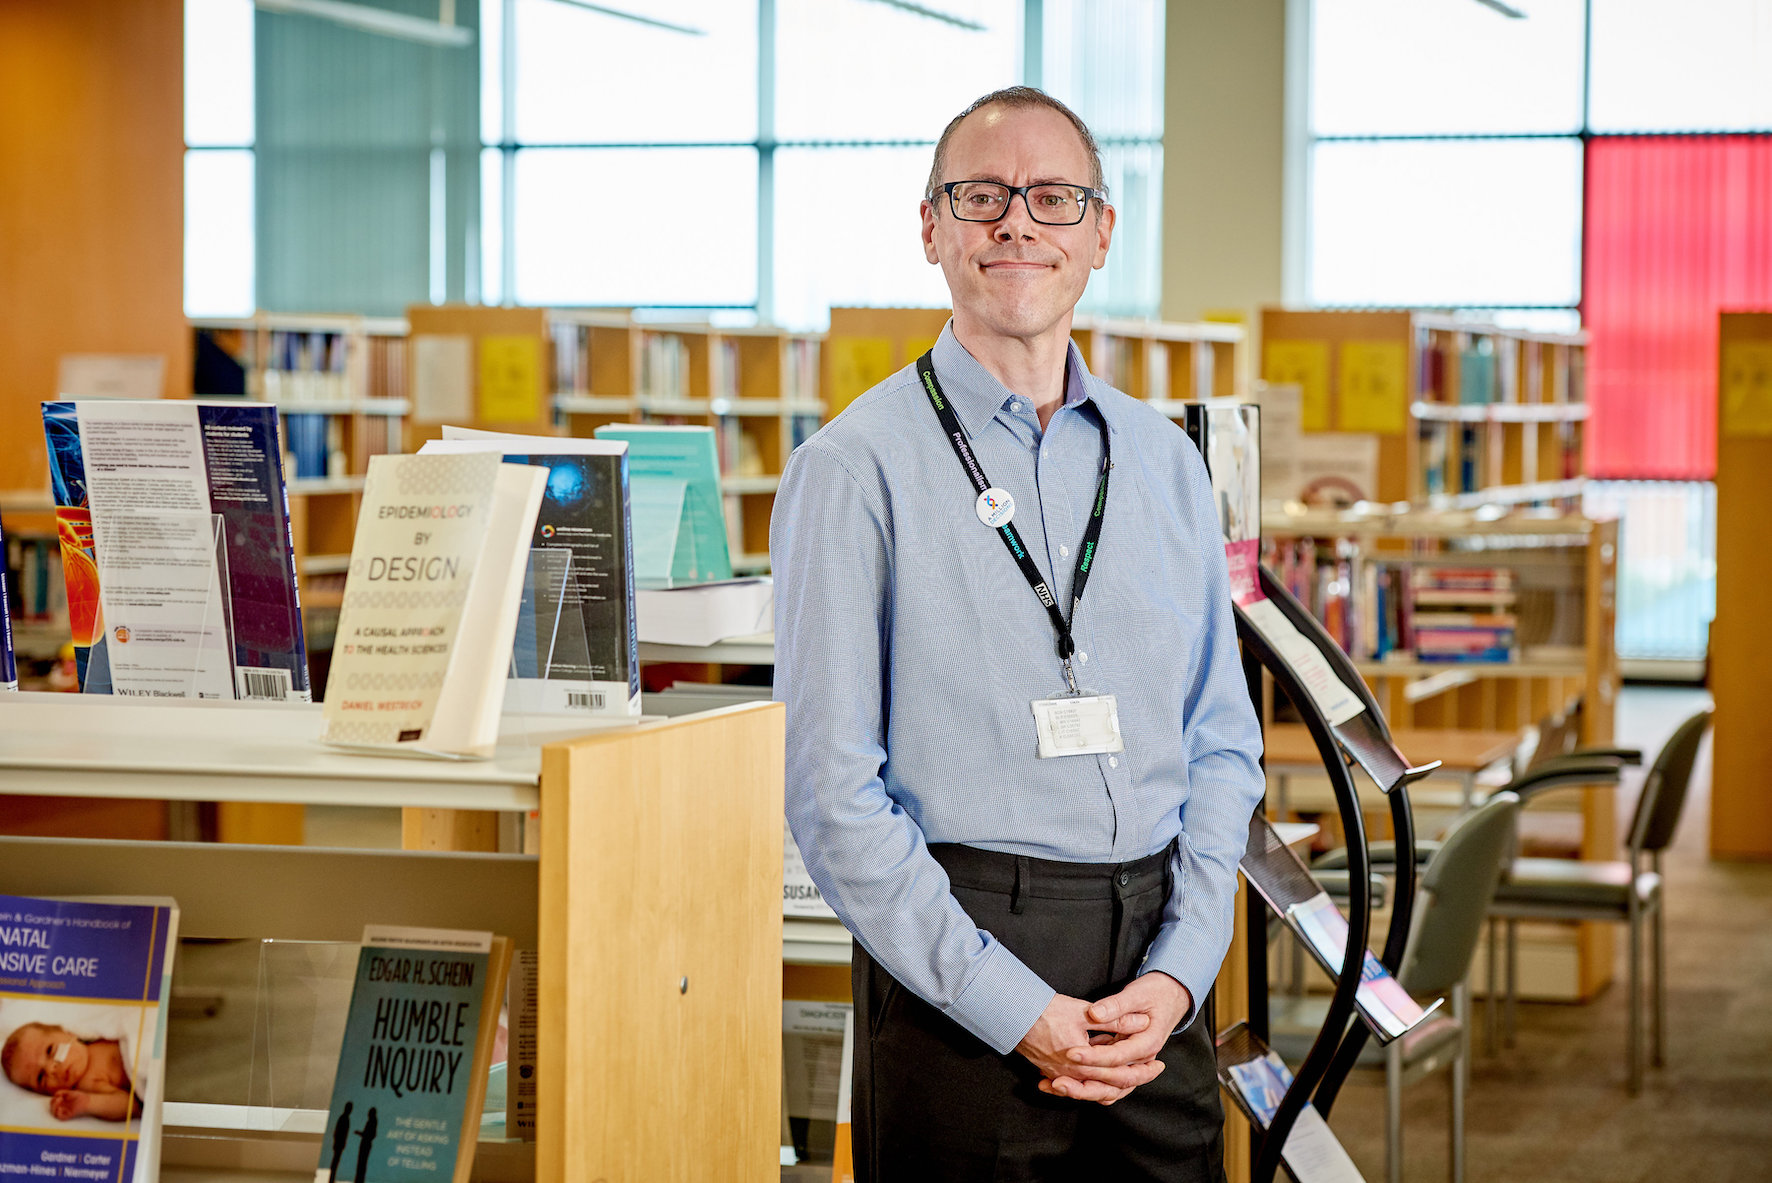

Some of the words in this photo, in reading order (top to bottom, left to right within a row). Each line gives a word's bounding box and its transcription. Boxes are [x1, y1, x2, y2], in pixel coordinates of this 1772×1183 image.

[923, 370, 945, 411] Compassion
[952, 431, 988, 492] Professionalism
[378, 504, 473, 519] EPIDEMIOLOGY
[992, 499, 1010, 516] MILLION
[414, 532, 432, 545] BY
[1002, 524, 1024, 559] eamwork
[1080, 541, 1095, 573] Respect
[368, 556, 460, 582] DESIGN
[1035, 584, 1053, 607] NHS
[355, 628, 360, 637] A
[363, 628, 397, 637] CAUSAL
[343, 645, 355, 654] TO
[357, 645, 372, 655] THE
[375, 645, 409, 655] HEALTH
[118, 688, 151, 697] WILEY
[153, 690, 186, 698] Blackwell
[341, 700, 374, 711] DANIEL
[24, 914, 71, 927] Gardner's
[73, 918, 120, 929] Handbook
[121, 920, 132, 929] of
[52, 956, 99, 977] CARE
[368, 957, 411, 983] EDGAR
[412, 960, 426, 985] H.
[428, 961, 475, 988] SCHEIN
[372, 997, 470, 1046] HUMBLE
[363, 1045, 463, 1098] INQUIRY
[395, 1116, 412, 1128] THE
[413, 1118, 447, 1131] GENTLE
[386, 1129, 404, 1140] ART
[405, 1131, 416, 1142] OF
[416, 1132, 449, 1145] ASKING
[395, 1144, 433, 1157] INSTEAD
[84, 1153, 111, 1166] Carter
[387, 1155, 399, 1168] OF
[400, 1157, 437, 1171] TELLING
